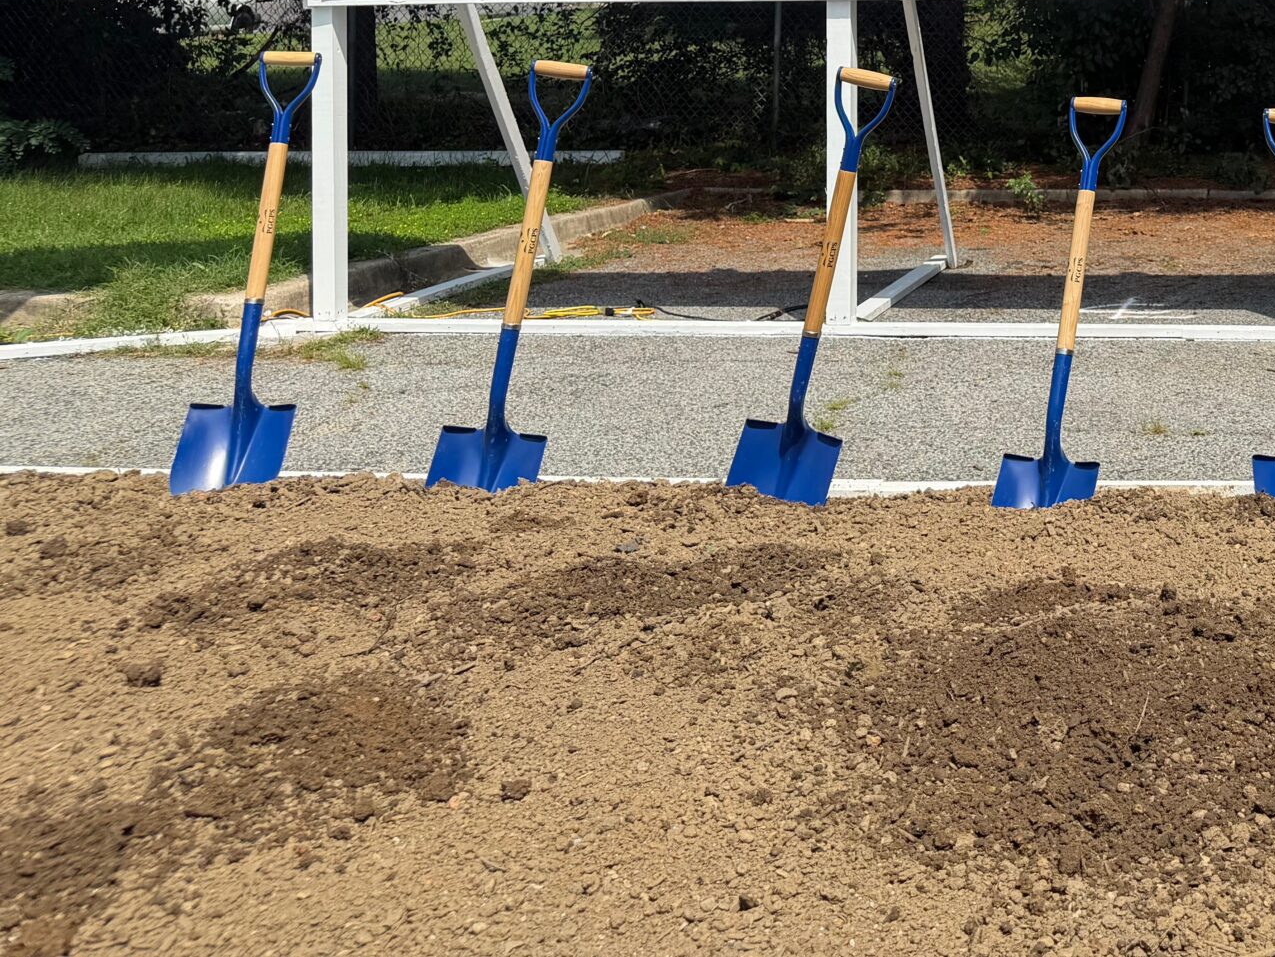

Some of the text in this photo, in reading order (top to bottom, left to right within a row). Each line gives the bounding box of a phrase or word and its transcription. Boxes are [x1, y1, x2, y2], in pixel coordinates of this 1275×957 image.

[266, 208, 275, 234] PGCPS
[528, 227, 538, 254] PGCPS
[827, 242, 838, 268] PGCPS
[1074, 257, 1083, 283] PGCPS
